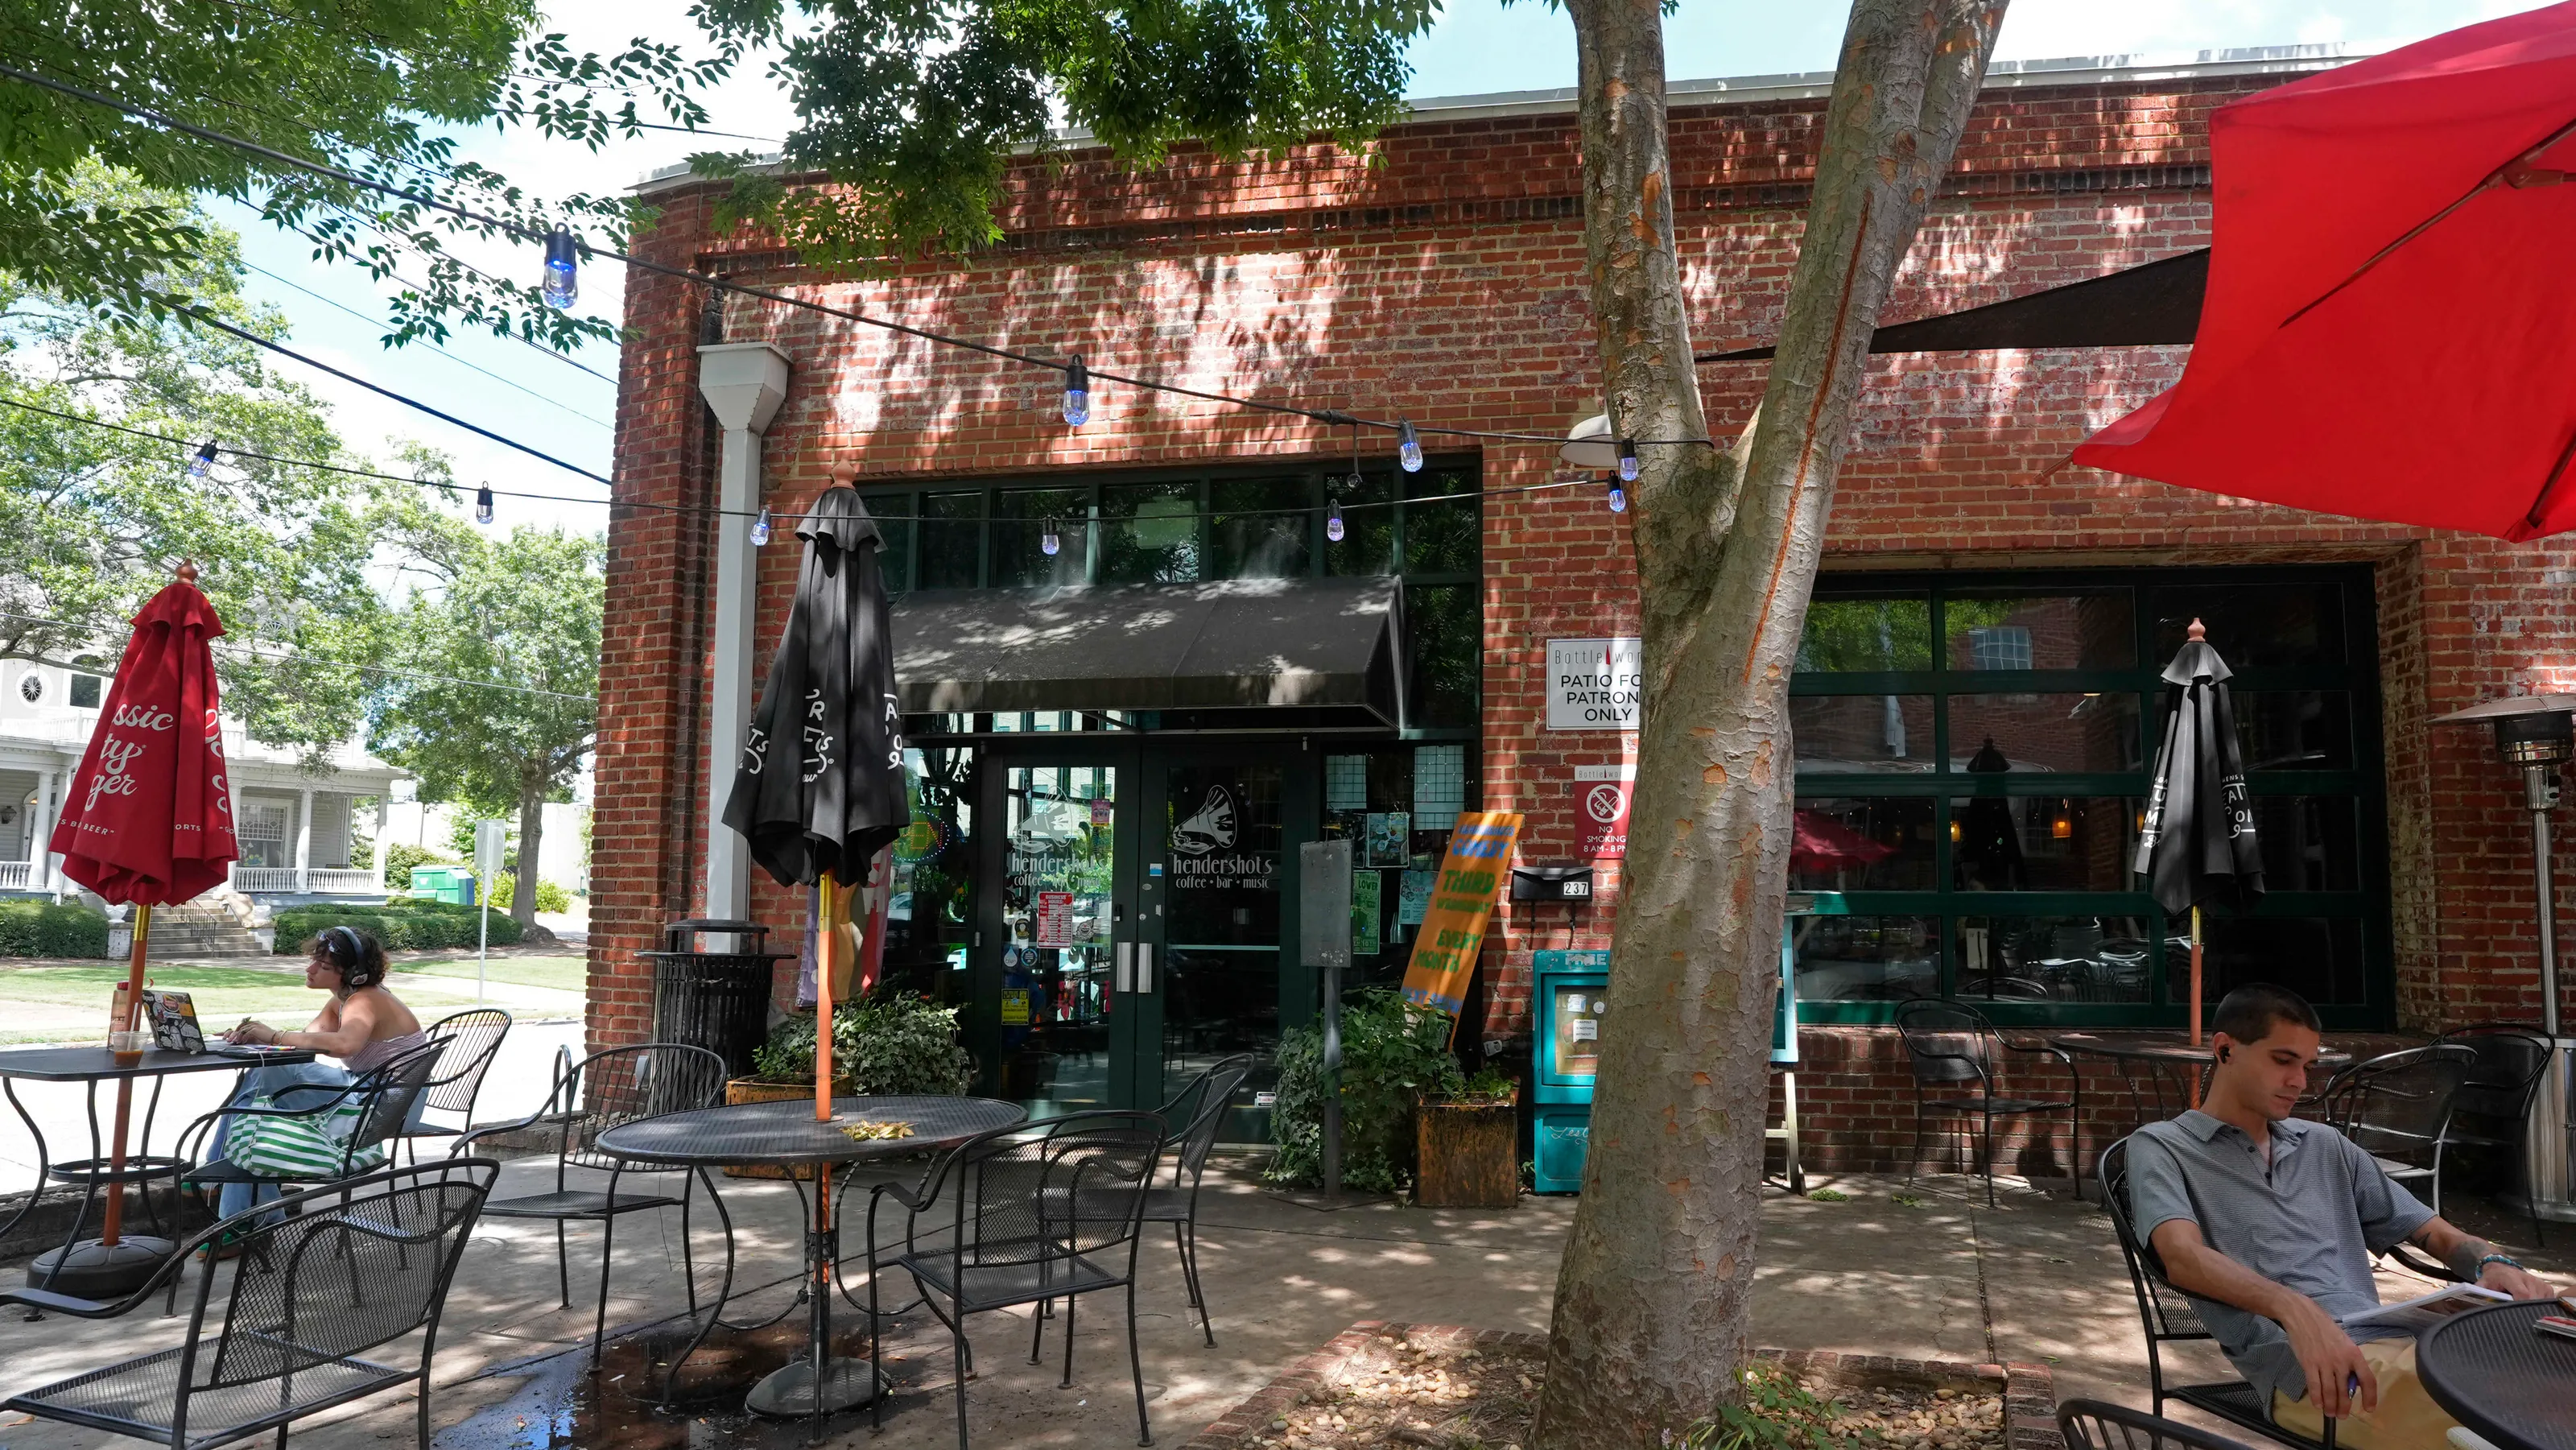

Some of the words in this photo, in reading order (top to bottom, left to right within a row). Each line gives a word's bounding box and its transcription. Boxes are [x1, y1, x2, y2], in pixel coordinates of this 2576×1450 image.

[1615, 651, 1641, 664] wor
[1561, 674, 1612, 688] PATIO
[1620, 674, 1641, 688] FO
[1567, 691, 1640, 704] PATRON
[111, 703, 174, 731] ssic
[1584, 708, 1633, 721] ONLY
[100, 733, 143, 775] ty
[84, 774, 138, 812] ger
[173, 823, 201, 832] ORTS
[1599, 825, 1613, 833] NO
[1587, 835, 1626, 843] SMOKING
[1452, 838, 1509, 859] COMEDY
[1583, 845, 1589, 853] 8
[1590, 845, 1604, 853] AM
[1610, 845, 1616, 853] 8
[1013, 873, 1043, 886] coffee
[1175, 874, 1208, 889] coffee
[1216, 874, 1233, 889] bar
[1242, 875, 1269, 889] music
[1442, 869, 1496, 895] THIRD
[1565, 882, 1587, 894] 237
[1436, 928, 1482, 952] EVERY
[1414, 949, 1461, 973] MONTH
